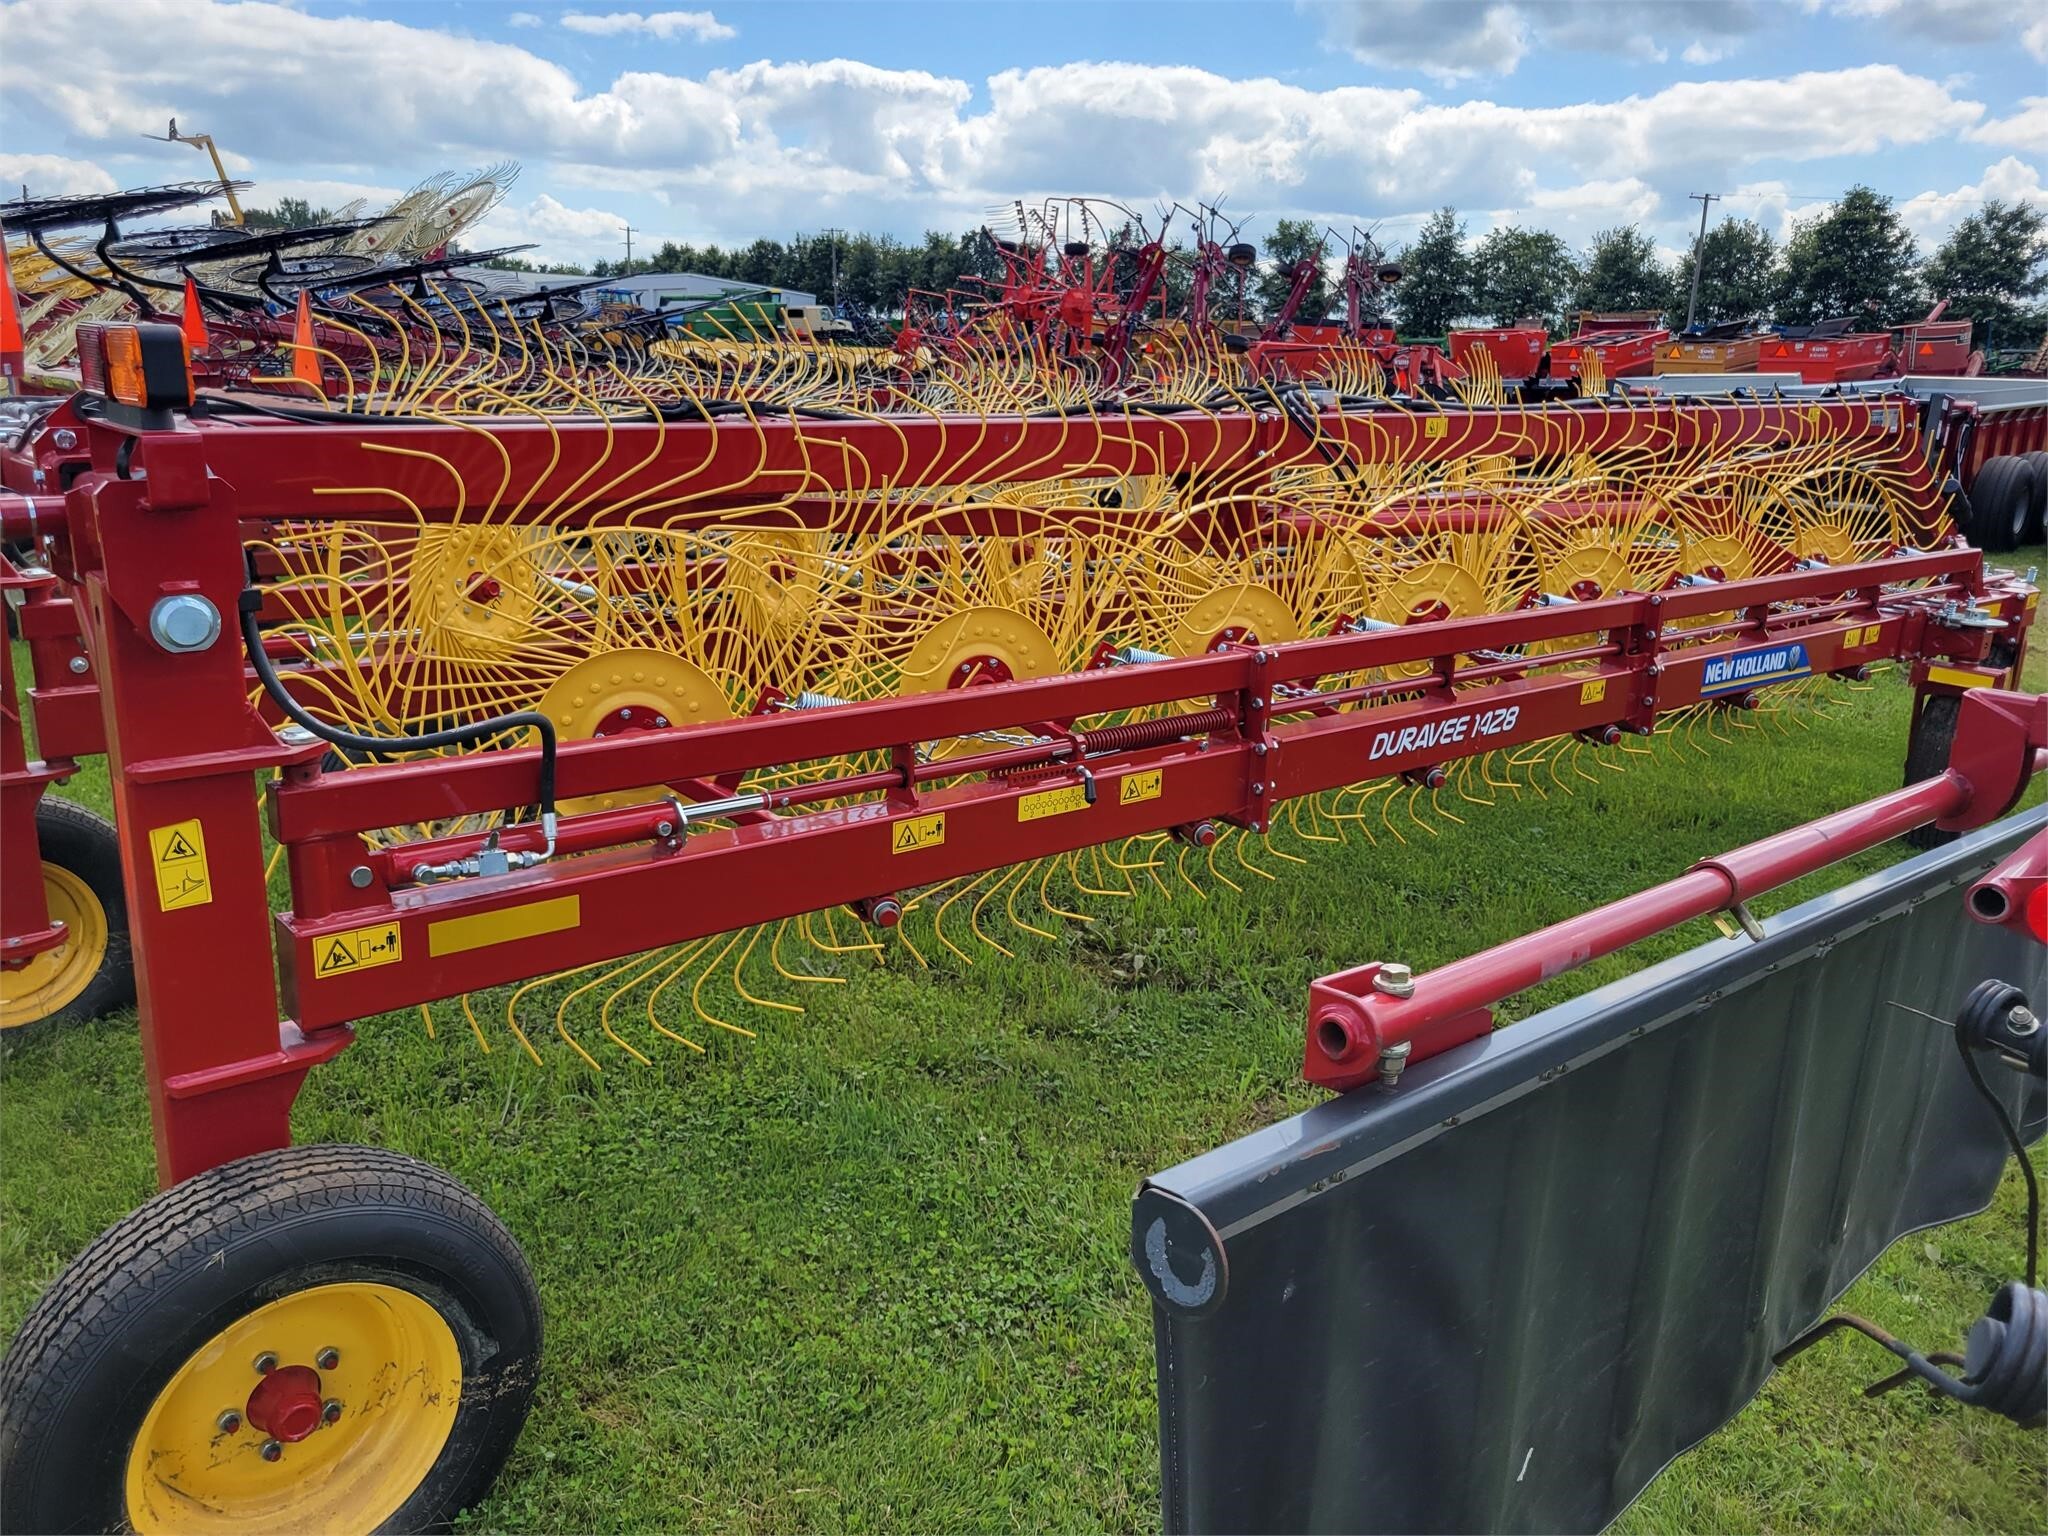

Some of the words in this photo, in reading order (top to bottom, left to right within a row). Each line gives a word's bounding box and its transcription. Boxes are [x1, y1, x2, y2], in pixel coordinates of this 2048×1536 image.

[1704, 661, 1735, 684] NEW
[1734, 651, 1787, 678] HOLLAND
[1369, 715, 1471, 760] DURAVEE
[1471, 705, 1520, 739] 1428
